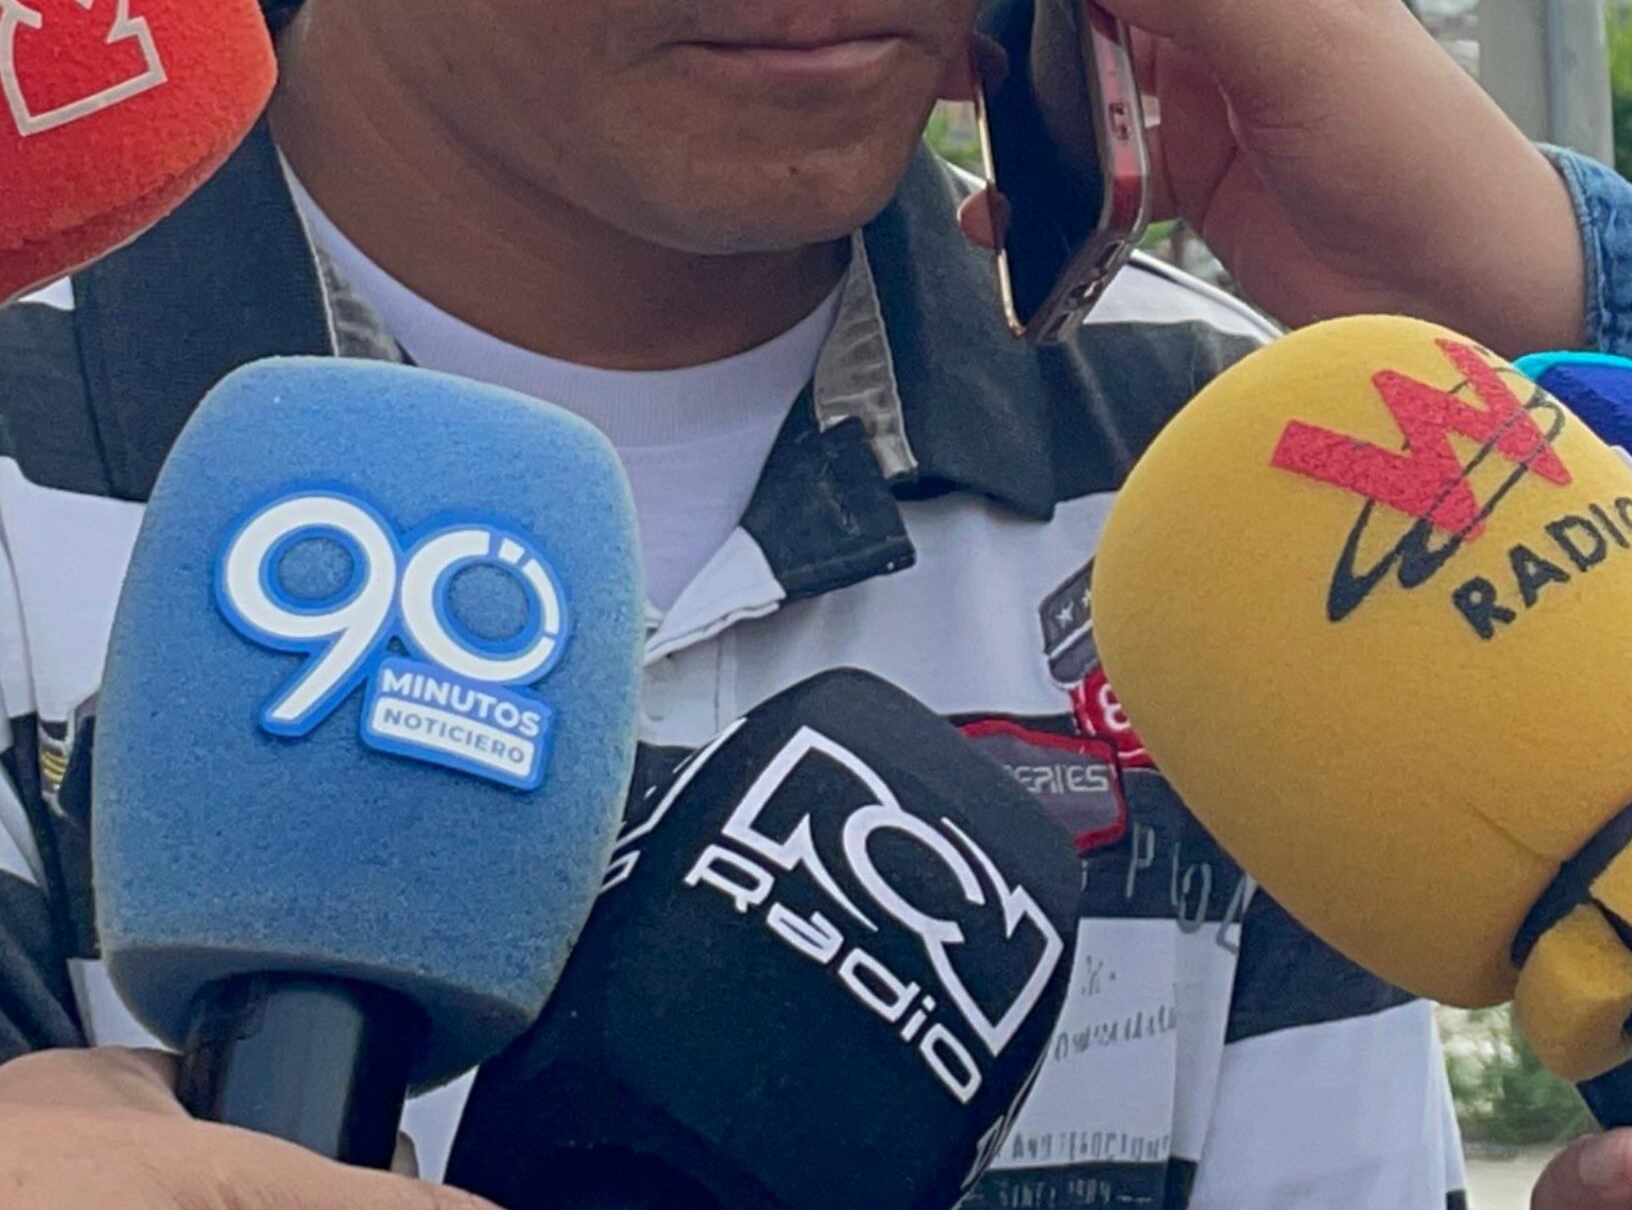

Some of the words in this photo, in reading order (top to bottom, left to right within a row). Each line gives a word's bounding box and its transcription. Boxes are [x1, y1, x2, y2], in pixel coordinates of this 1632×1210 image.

[224, 496, 562, 721] 90
[382, 668, 541, 737] MINUTOS
[383, 707, 526, 764] NOTICIERO
[685, 843, 982, 1104] Radio
